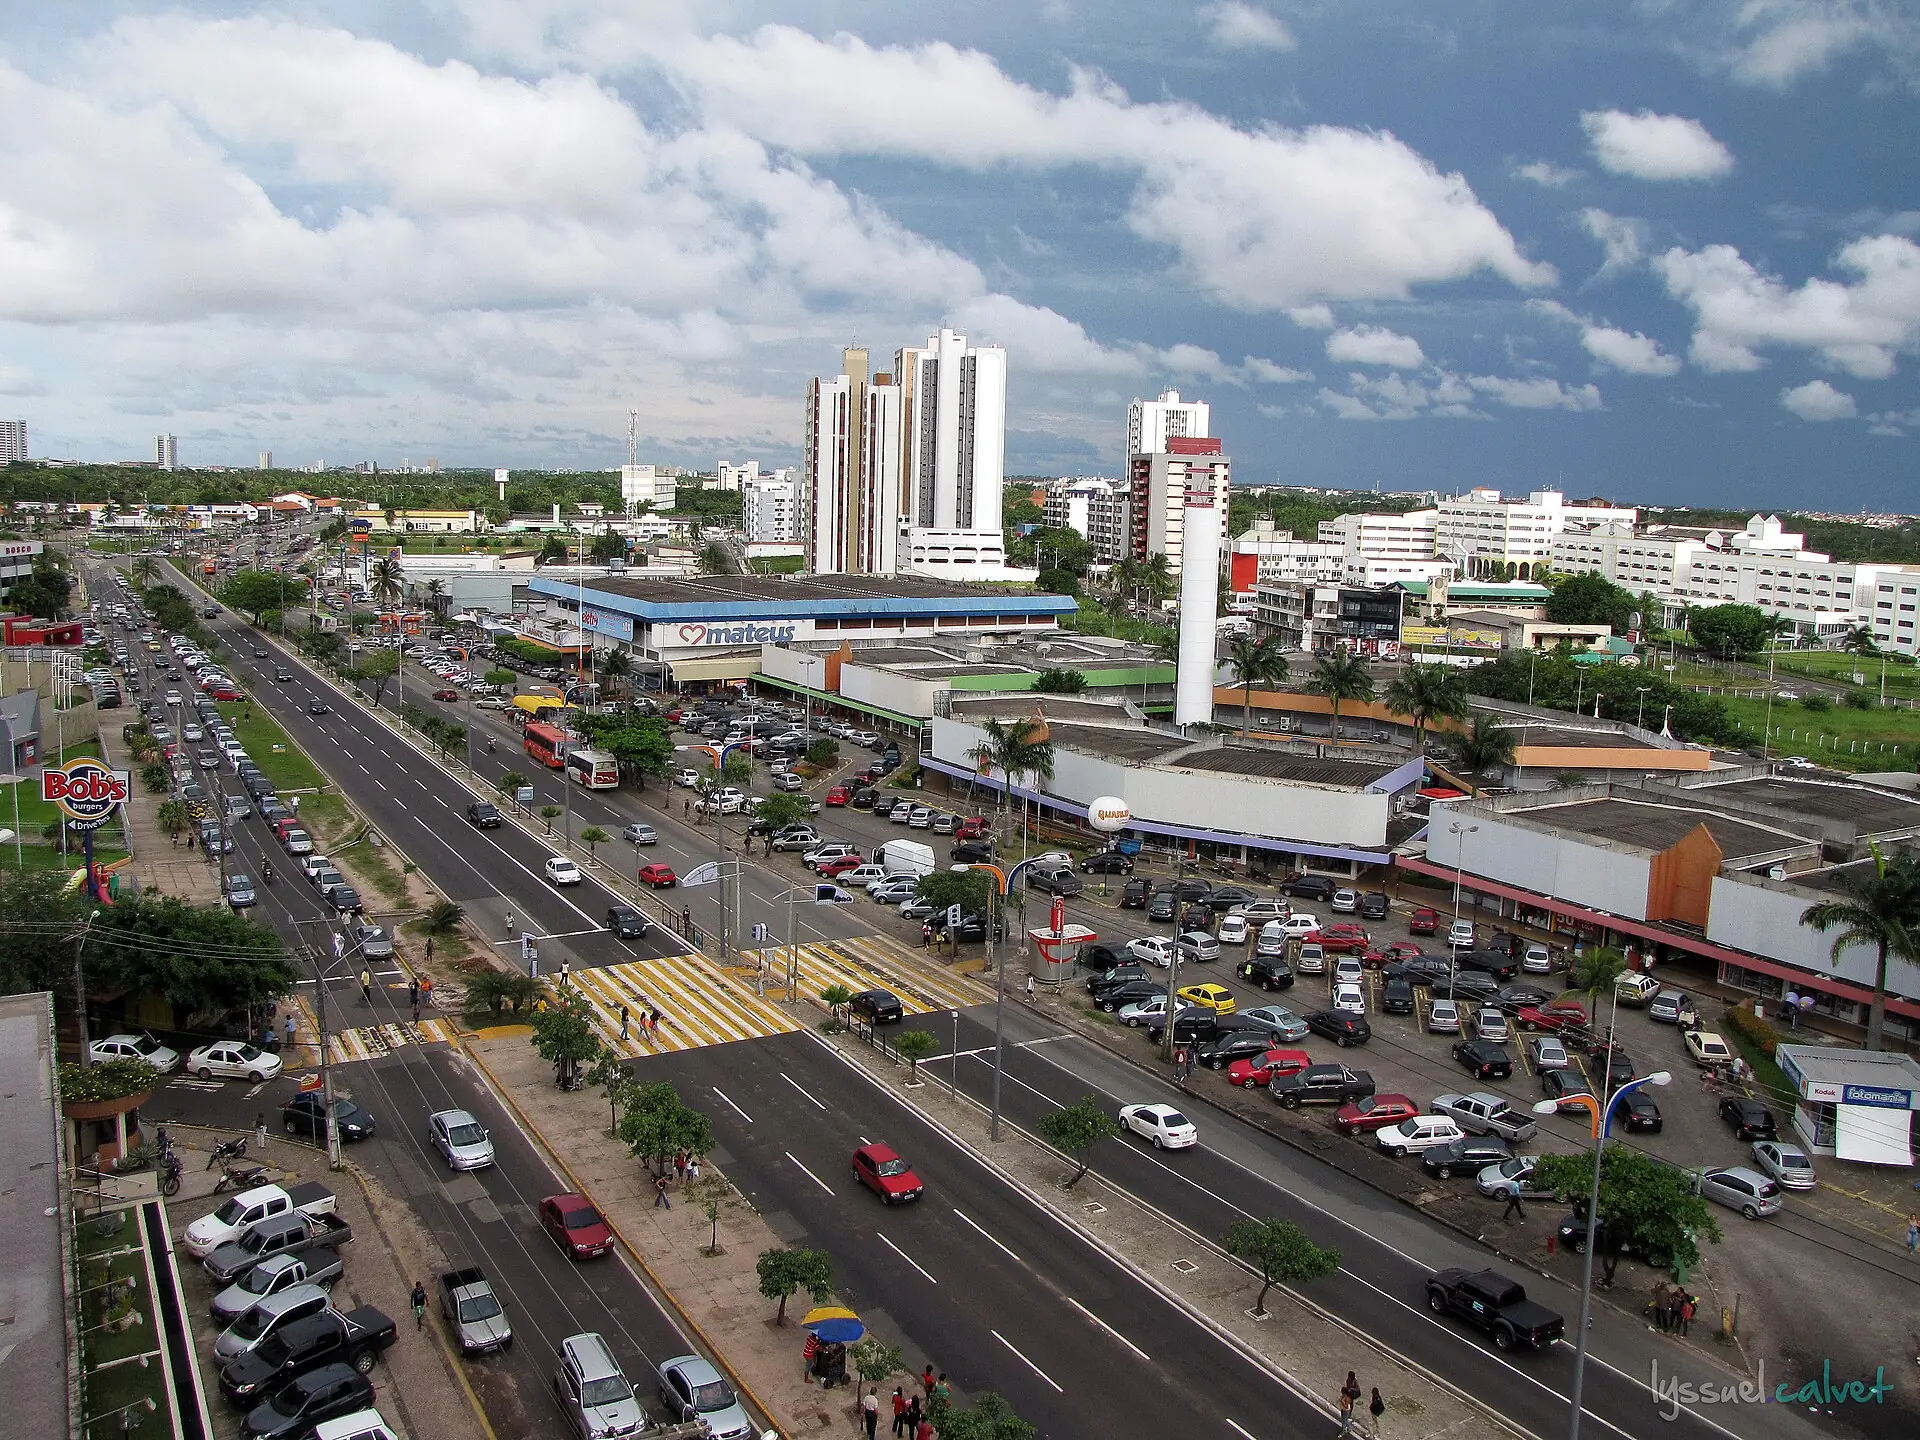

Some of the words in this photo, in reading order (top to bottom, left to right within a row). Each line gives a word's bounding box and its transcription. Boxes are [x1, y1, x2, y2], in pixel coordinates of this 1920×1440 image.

[705, 623, 796, 645] mateus
[43, 770, 128, 802] Bob's
[72, 802, 104, 812] burgers
[77, 820, 98, 831] Drive
[95, 814, 112, 826] Thru
[1814, 1088, 1836, 1097] Kodak
[1846, 1086, 1908, 1104] fotomania
